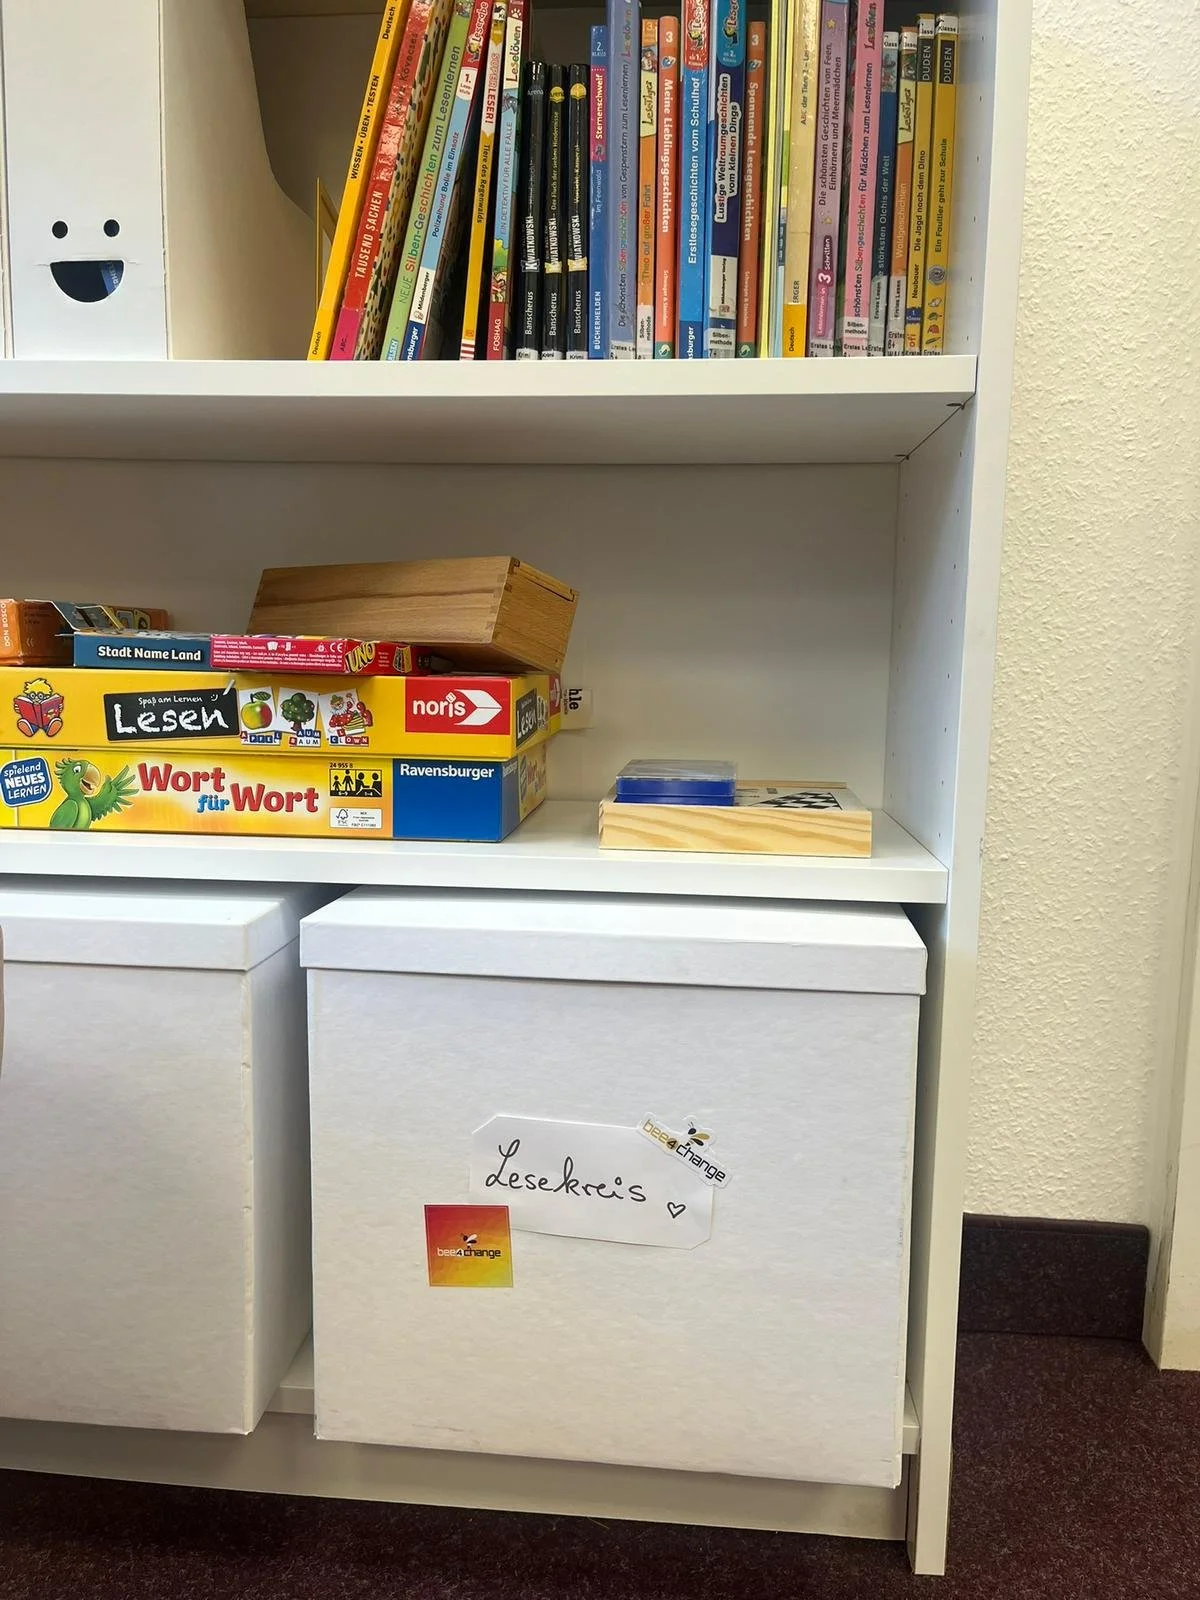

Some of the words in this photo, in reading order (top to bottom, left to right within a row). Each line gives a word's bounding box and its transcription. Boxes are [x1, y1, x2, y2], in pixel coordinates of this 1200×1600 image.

[382, 6, 395, 40] Deutsch
[472, 2, 488, 42] Leserabe
[665, 31, 673, 43] 3
[506, 26, 521, 82] Leselöwen
[752, 34, 759, 46] 3
[824, 43, 832, 66] Feen,
[944, 47, 952, 82] DUDEN
[436, 46, 460, 121] Lesenlernen
[665, 79, 673, 114] Meine
[831, 57, 841, 120] Meermädchen
[862, 62, 873, 114] Lesenlernen
[595, 74, 603, 140] Sternenschweif
[642, 80, 654, 125] LeseTiger
[690, 77, 699, 126] Schulhof
[743, 82, 758, 145] Spannende
[821, 87, 830, 141] Geschichten
[899, 88, 913, 132] LeseTiger
[350, 146, 364, 179] WISSEN
[360, 115, 370, 138] ÜBEN
[366, 75, 379, 107] TESTEN
[719, 76, 728, 181] Weltraumgeschichten
[729, 105, 739, 133] Dings
[831, 123, 839, 139] und
[430, 125, 444, 151] zum
[448, 132, 459, 160] Einsatz
[691, 130, 699, 152] vom
[728, 136, 737, 170] kleinen
[939, 138, 947, 167] Schule
[445, 162, 452, 171] im
[500, 185, 508, 219] DETEKTIV
[504, 122, 512, 144] FÄLLE
[620, 132, 629, 182] Gespenstern
[820, 144, 828, 188] schönsten
[829, 142, 838, 190] Einhörnern
[860, 136, 869, 176] Mädchen
[882, 155, 890, 175] Welt
[441, 172, 449, 192] Bolle
[661, 118, 672, 232] Lieblingsgeschichten
[727, 173, 736, 193] vom
[858, 179, 867, 191] für
[917, 171, 925, 190] dem
[477, 179, 486, 223] Regenwalds
[642, 184, 650, 208] Fahrt
[688, 155, 700, 264] Erstlesegeschichten
[717, 185, 726, 220] Lustige
[743, 150, 755, 241] Lesegeschichten
[819, 191, 827, 206] Die
[880, 195, 888, 224] Olchis
[935, 184, 945, 204] geht
[405, 154, 438, 272] Silben-Geschichten
[432, 194, 446, 237] Polizeihund
[643, 210, 651, 239] großer
[895, 183, 907, 258] Waldgeschichten
[915, 216, 923, 235] Jagd
[935, 205, 943, 233] Faultier
[355, 234, 373, 278] TAUSEND
[366, 191, 383, 231] SACHEN
[525, 216, 537, 270] KWIATKOWSKI
[620, 200, 628, 271] Silbengeschichten
[855, 194, 866, 271] Silbengeschichten
[879, 226, 887, 269] stärksten
[913, 237, 921, 251] Die
[399, 277, 412, 303] NEUE
[418, 272, 429, 310] Mildenberger
[618, 274, 627, 313] schönsten
[818, 273, 831, 284] 3
[525, 291, 533, 335] Banscherus
[573, 290, 581, 334] Banscherus
[853, 274, 863, 318] schönsten
[493, 319, 501, 351] FOSHAG
[618, 315, 627, 327] Die
[312, 331, 321, 355] Deutsch
[98, 646, 132, 658] Stadt
[134, 648, 169, 659] Name
[171, 650, 201, 661] Land
[345, 642, 375, 672] UNO
[114, 704, 229, 734] Lesen
[138, 696, 157, 708] Spaß
[413, 692, 466, 718] noris
[4, 762, 41, 778] spielend
[4, 772, 45, 789] NEUES
[137, 762, 225, 792] Wort
[400, 764, 494, 780] Ravensburger
[8, 784, 47, 799] LERNEN
[197, 794, 230, 813] für
[230, 782, 319, 813] Wort
[642, 1118, 726, 1183] bee4change
[485, 1138, 647, 1202] Lesekreis
[437, 1247, 501, 1259] bee4change
